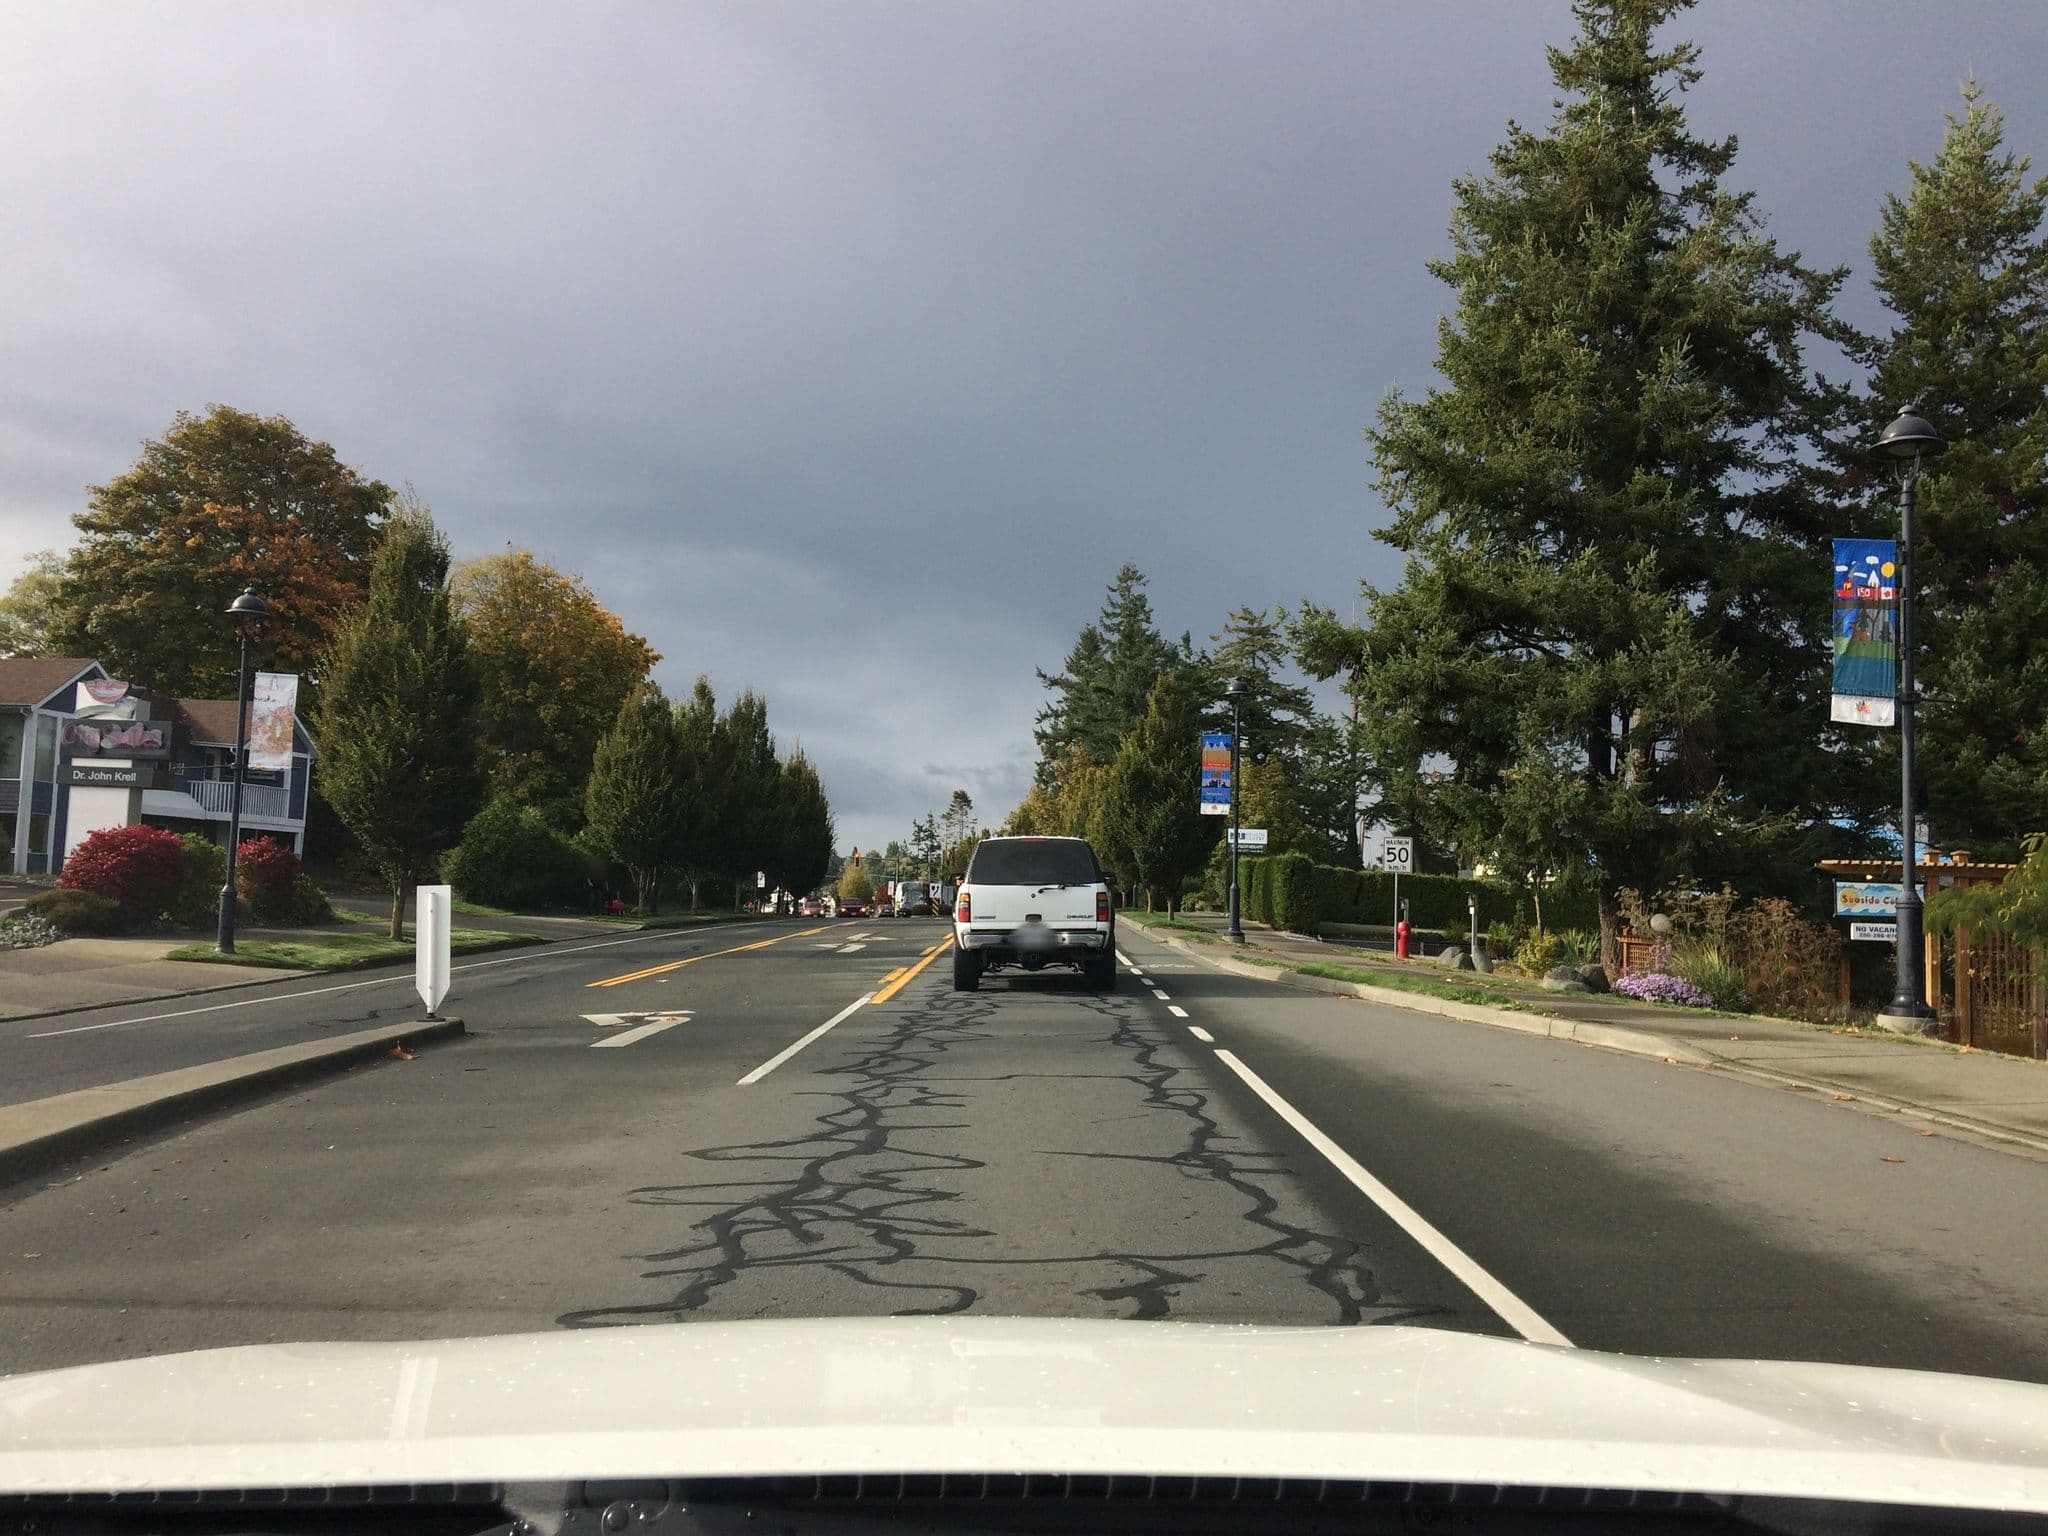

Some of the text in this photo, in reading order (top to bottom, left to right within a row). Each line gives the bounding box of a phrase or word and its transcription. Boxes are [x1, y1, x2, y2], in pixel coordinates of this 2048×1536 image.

[73, 770, 137, 781] Dr. John Krell
[1386, 847, 1409, 863] 50
[1841, 895, 1880, 905] Seaside
